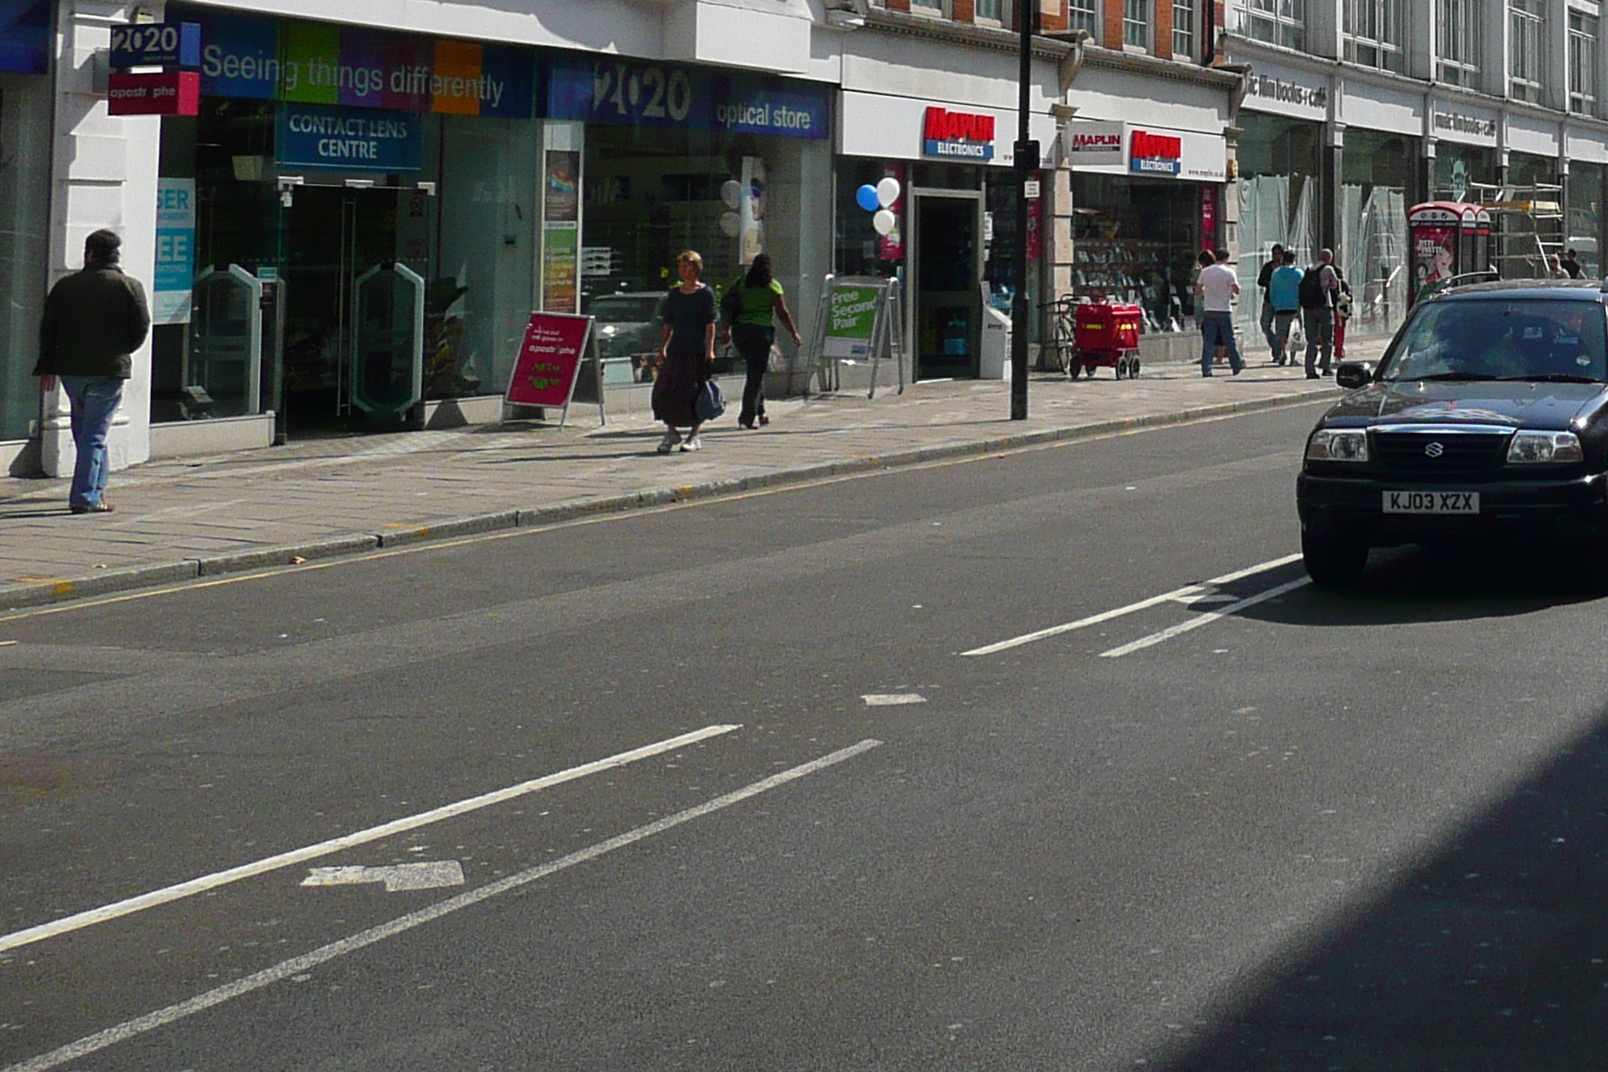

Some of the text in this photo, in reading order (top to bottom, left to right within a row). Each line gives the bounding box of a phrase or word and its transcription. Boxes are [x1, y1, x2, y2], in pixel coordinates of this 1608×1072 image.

[202, 44, 505, 108] Seeing things differently
[110, 86, 176, 99] apostrphe
[717, 99, 811, 129] optical store
[925, 106, 995, 141] MAPLIN
[289, 113, 408, 139] CONTACT LENS
[317, 138, 378, 159] CENTRE
[937, 141, 984, 157] ELECTRONICS
[1073, 133, 1121, 146] MAPLIN
[1131, 129, 1182, 159] MAPLIN
[1140, 158, 1174, 172] ELECTRONICS
[831, 291, 859, 305] Free
[832, 295, 878, 318] Second
[833, 317, 858, 330] Pair
[1390, 492, 1473, 511] KJ03 XZX
